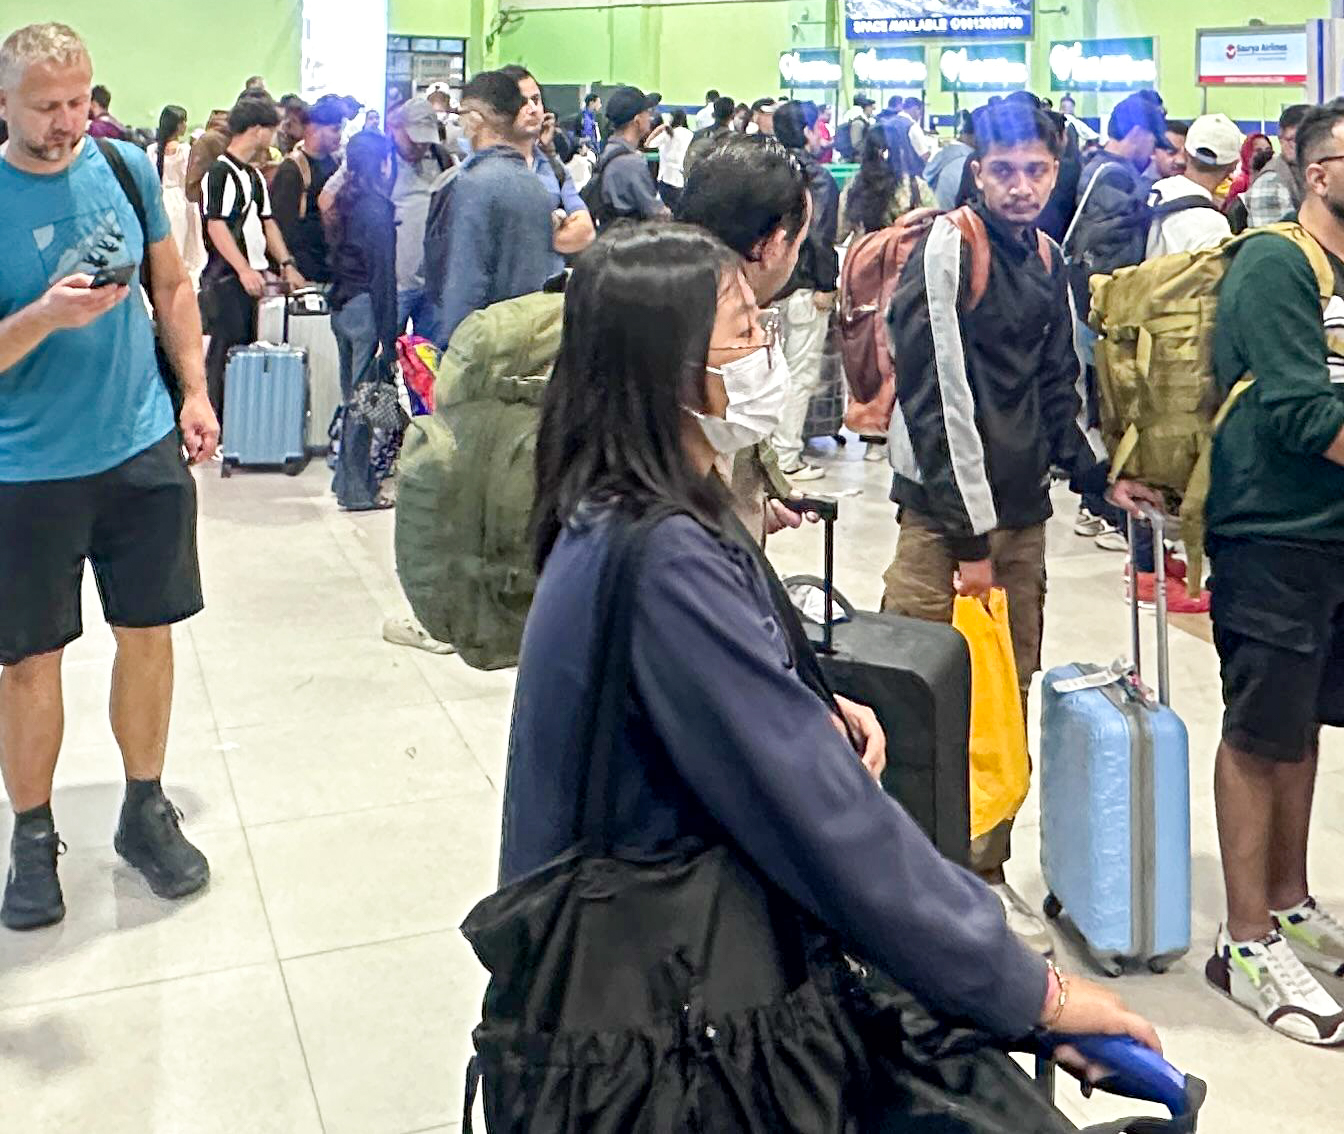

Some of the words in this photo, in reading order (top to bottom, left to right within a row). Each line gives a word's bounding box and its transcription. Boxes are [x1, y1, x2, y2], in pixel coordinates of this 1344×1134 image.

[853, 19, 888, 33] SPACE
[889, 17, 947, 32] AVAILABLE
[1236, 43, 1259, 54] Saurya
[1261, 42, 1287, 51] Airlines
